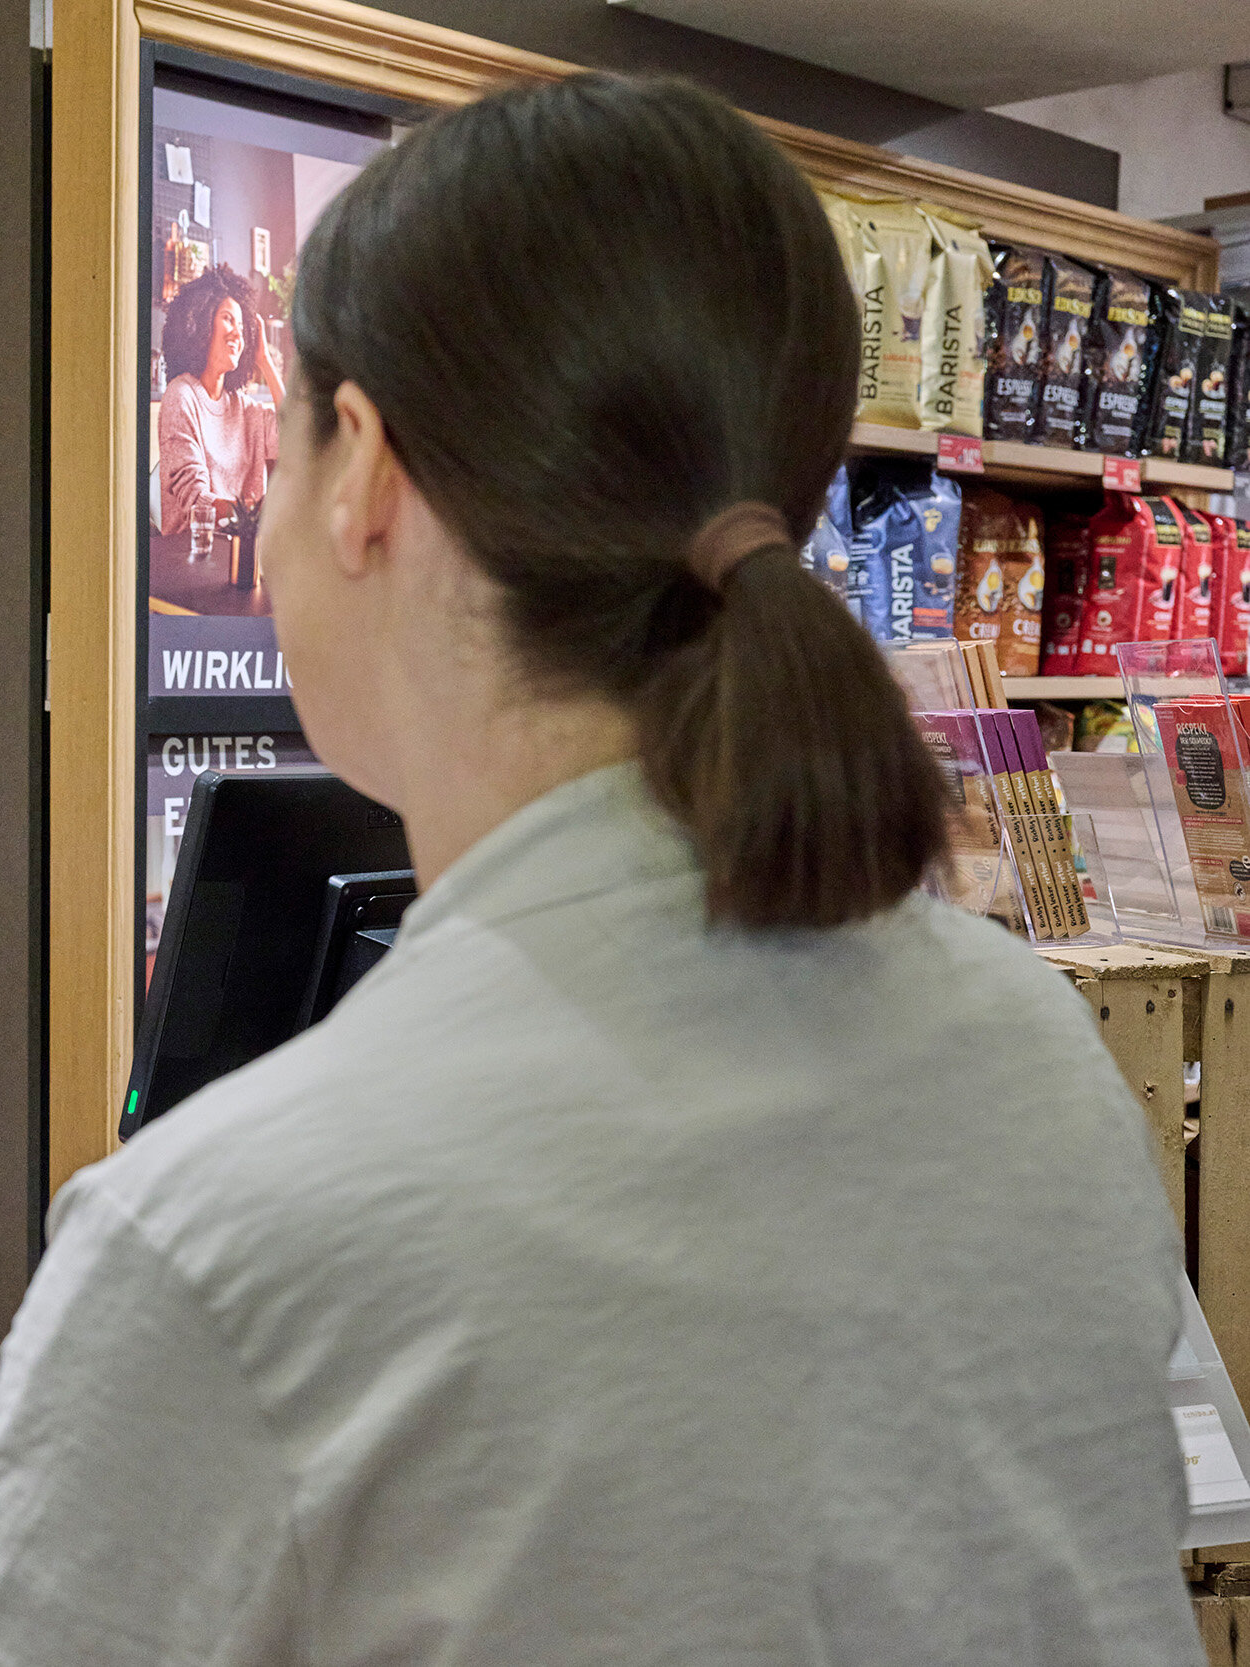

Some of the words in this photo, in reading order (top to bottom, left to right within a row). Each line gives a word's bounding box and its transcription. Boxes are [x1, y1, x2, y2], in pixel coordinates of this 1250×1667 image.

[860, 286, 884, 399] BARISTA
[936, 305, 962, 416] BARISTA
[892, 543, 914, 640] ARISTA
[162, 736, 276, 776] GUTES
[164, 796, 192, 836] E
